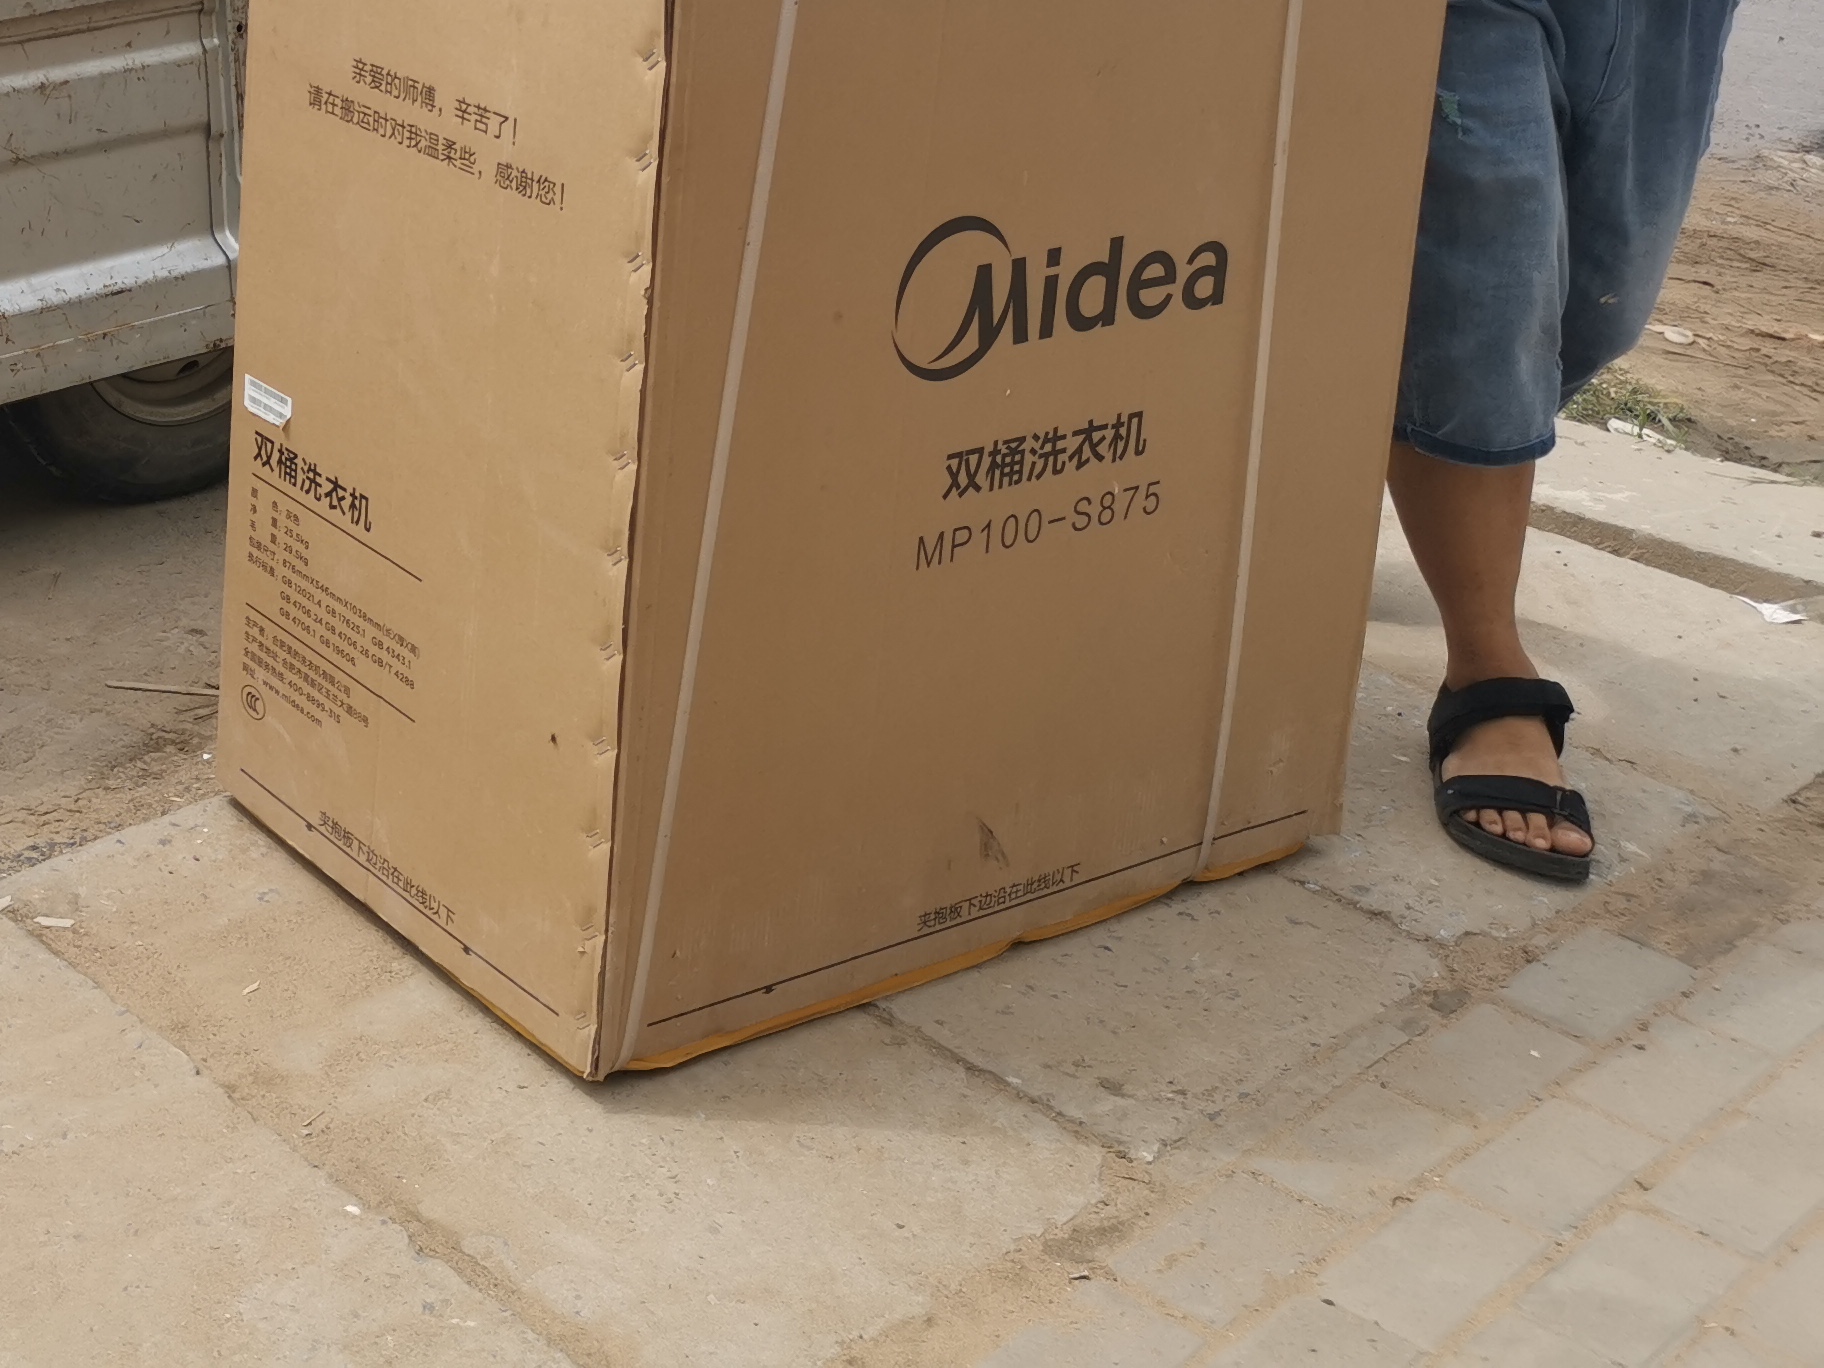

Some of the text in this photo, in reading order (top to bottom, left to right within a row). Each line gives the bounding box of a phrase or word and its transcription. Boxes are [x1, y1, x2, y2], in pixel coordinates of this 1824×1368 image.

[918, 230, 1229, 368] Midea
[253, 430, 372, 533] 双桶洗衣机
[942, 410, 1148, 501] 双桶洗衣机
[914, 478, 1162, 571] MP100-S875
[317, 810, 456, 927] 夹抱板下边沿在此线以下
[917, 862, 1081, 932] 夹抱板下边沿在此线以下
